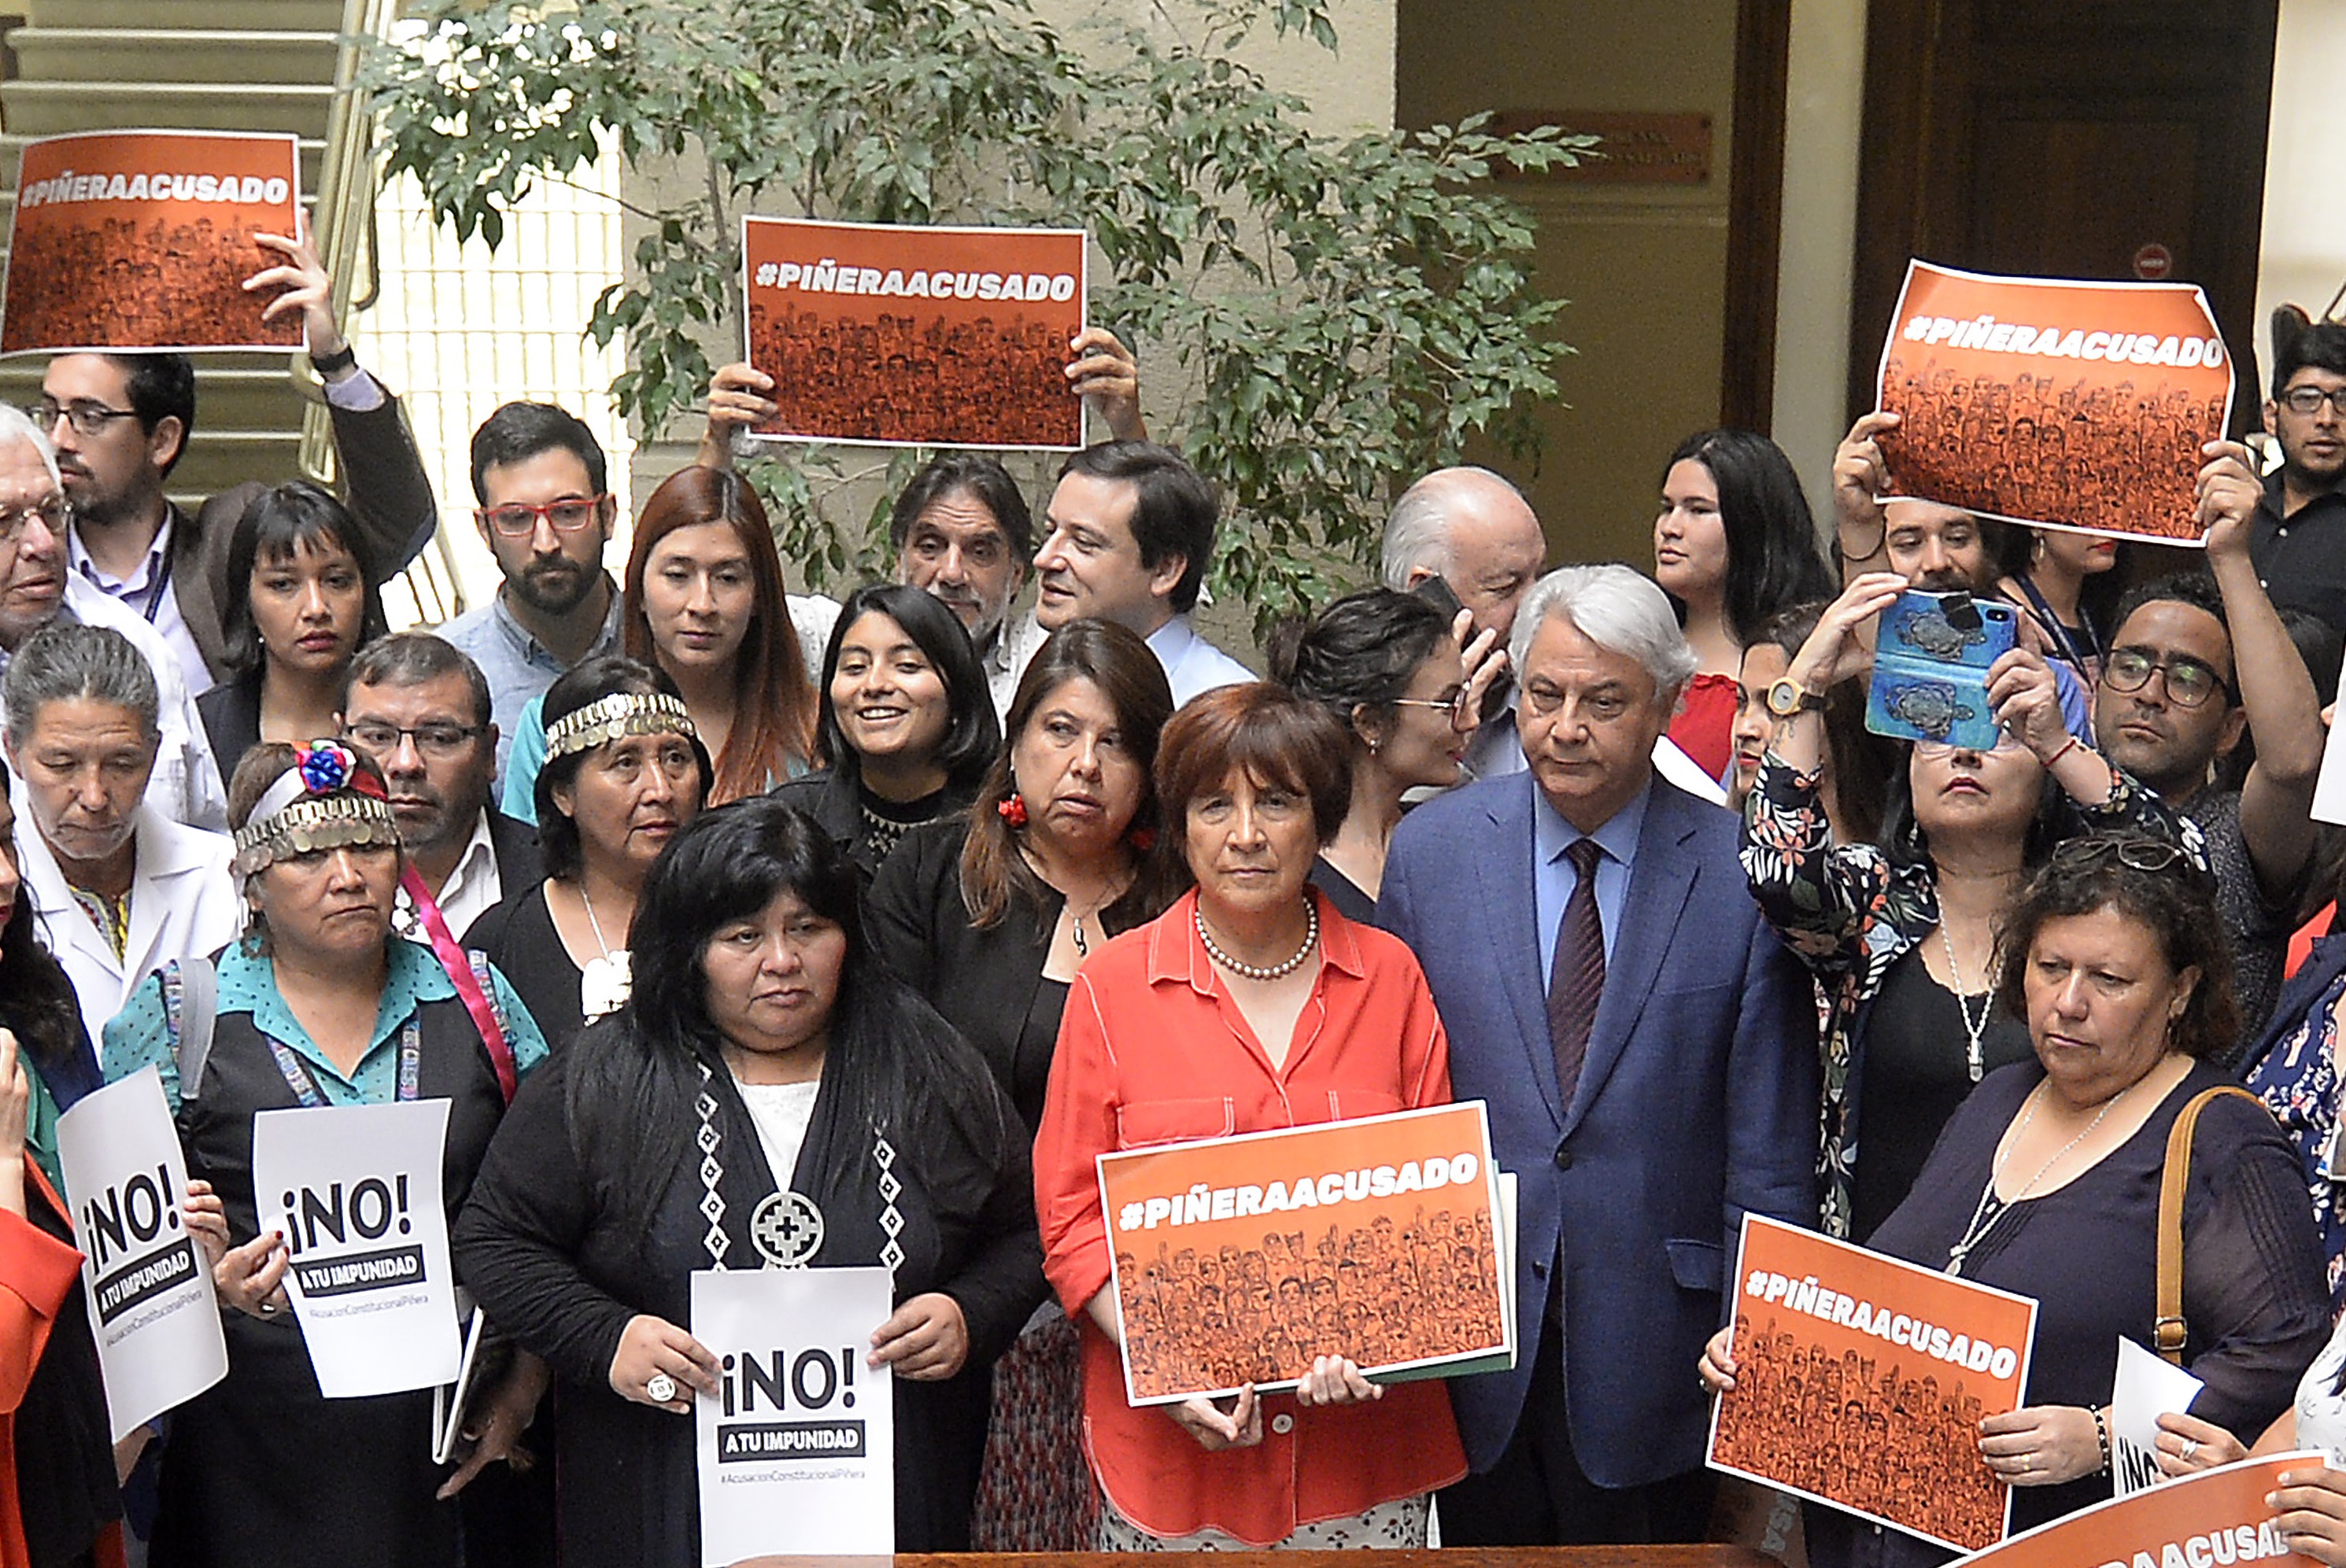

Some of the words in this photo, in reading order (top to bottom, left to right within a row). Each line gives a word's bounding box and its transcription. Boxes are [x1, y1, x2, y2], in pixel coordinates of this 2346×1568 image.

[20, 170, 289, 208] #PIÑERAACUSADO
[755, 258, 1076, 301] #PIÑERAACUSADO
[1903, 315, 2223, 368] #PIÑERAACUSADO
[83, 1163, 179, 1275] ¡NO!
[283, 1175, 411, 1254] ¡NO!
[1119, 1153, 1480, 1230] #PIÑERAACUSADO
[101, 1292, 109, 1313] A
[105, 1282, 121, 1307] TU
[120, 1250, 190, 1298] IMPUNIDAD
[301, 1271, 312, 1289] A
[310, 1267, 331, 1289] TU
[331, 1255, 418, 1285] IMPUNIDAD
[1745, 1270, 2017, 1379] #PIÑERAACUSADO
[722, 1348, 855, 1417] ¡NO!
[726, 1433, 739, 1453] A
[738, 1432, 761, 1452] TU
[763, 1429, 859, 1450] IMPUNIDAD
